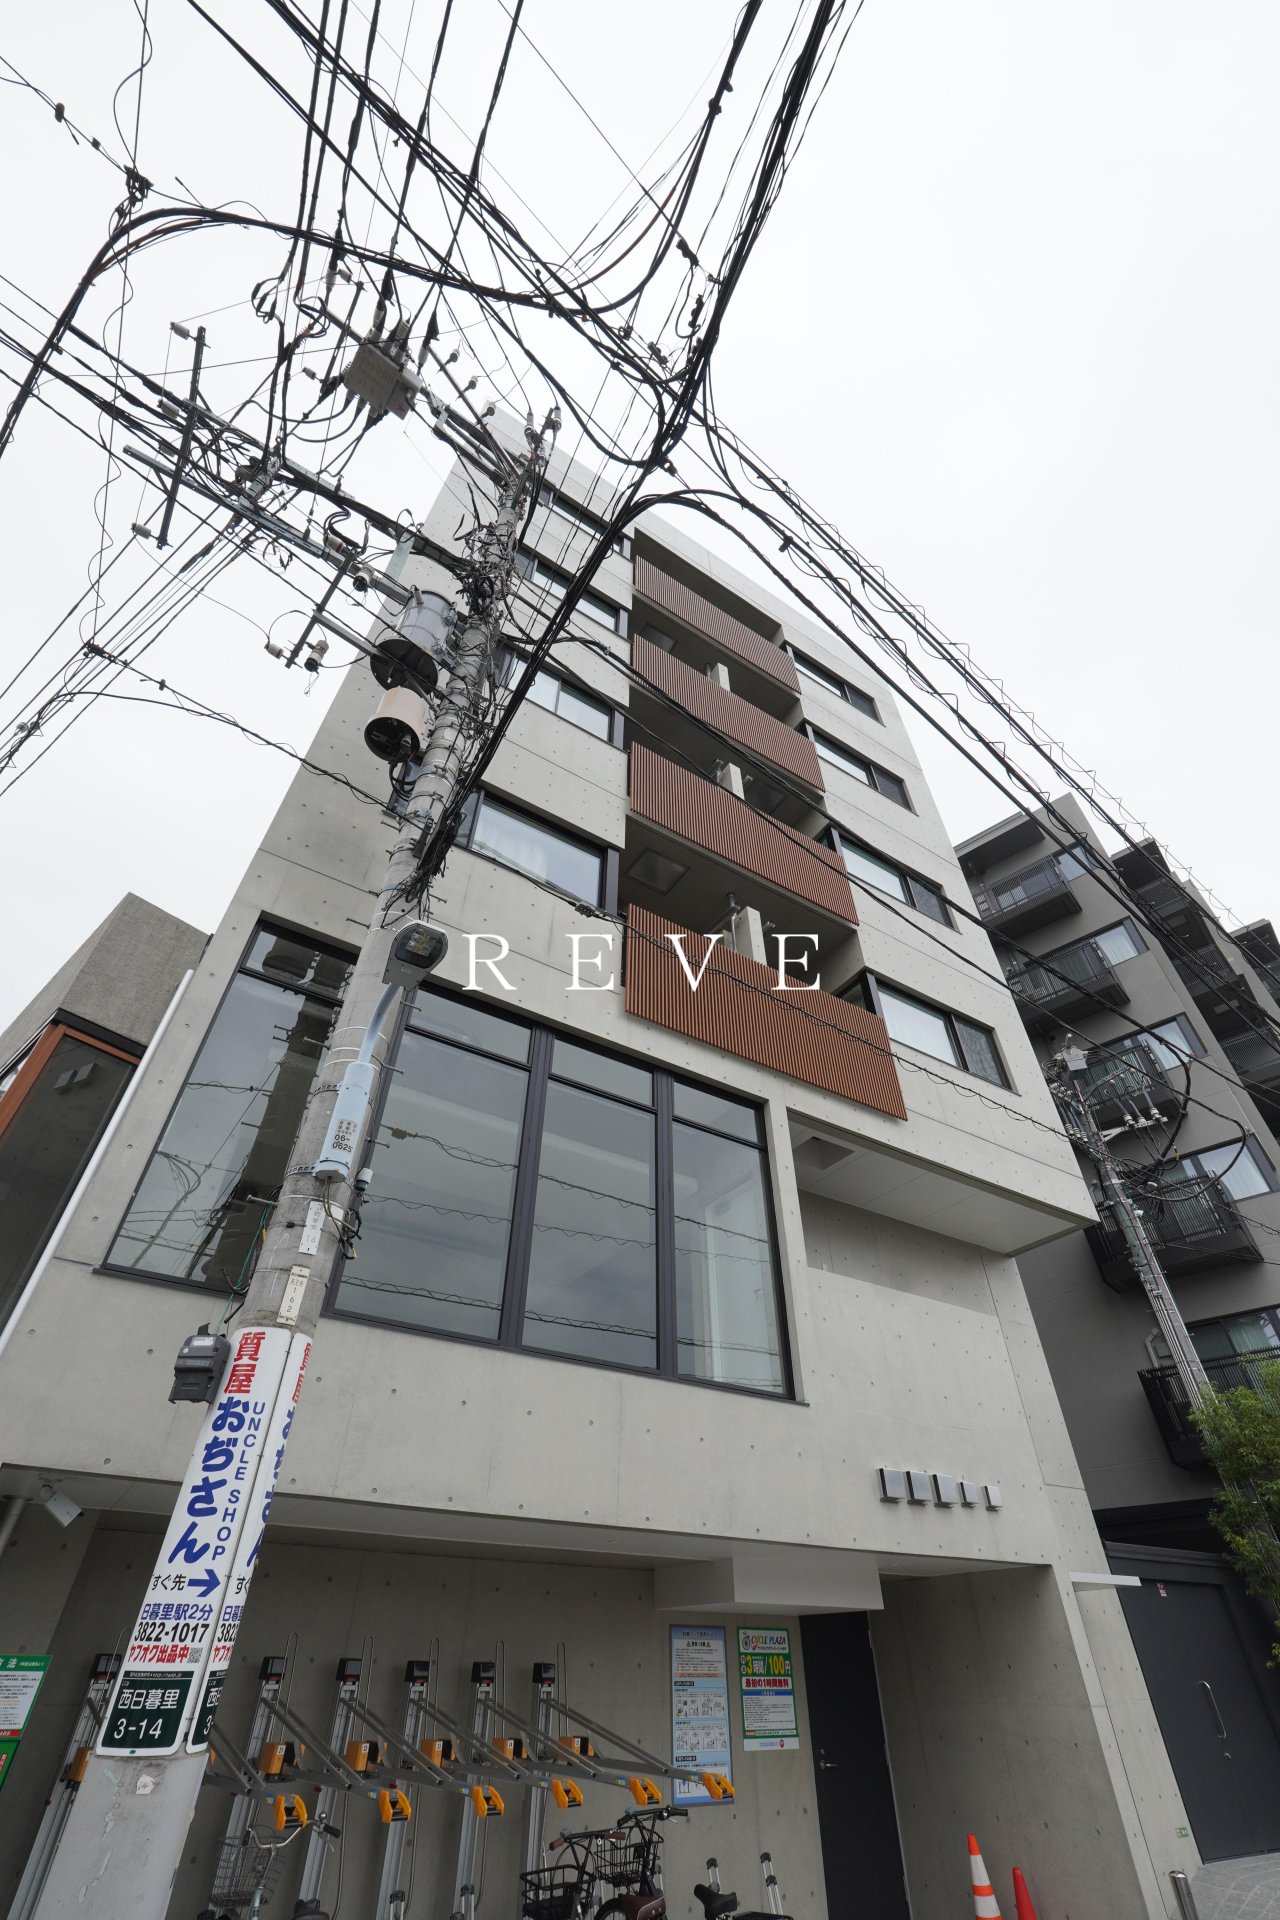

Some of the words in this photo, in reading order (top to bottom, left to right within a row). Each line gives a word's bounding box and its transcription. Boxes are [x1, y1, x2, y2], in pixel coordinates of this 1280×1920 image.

[332, 1141, 353, 1153] 0625
[334, 1134, 350, 1142] 06-
[224, 1331, 266, 1394] 質屋
[234, 1401, 266, 1481] UNCLE
[168, 1396, 250, 1564] おぢさん
[211, 1489, 241, 1561] SHOP
[151, 1574, 187, 1591] すぐ先
[141, 1603, 213, 1621] 日暮里駅2分
[134, 1622, 210, 1643] 3822-1017
[769, 1635, 786, 1645] PLAZA
[127, 1644, 190, 1664] ヤフオク出品中
[118, 1688, 180, 1709] 西日暮里
[114, 1718, 163, 1739] 3-14
